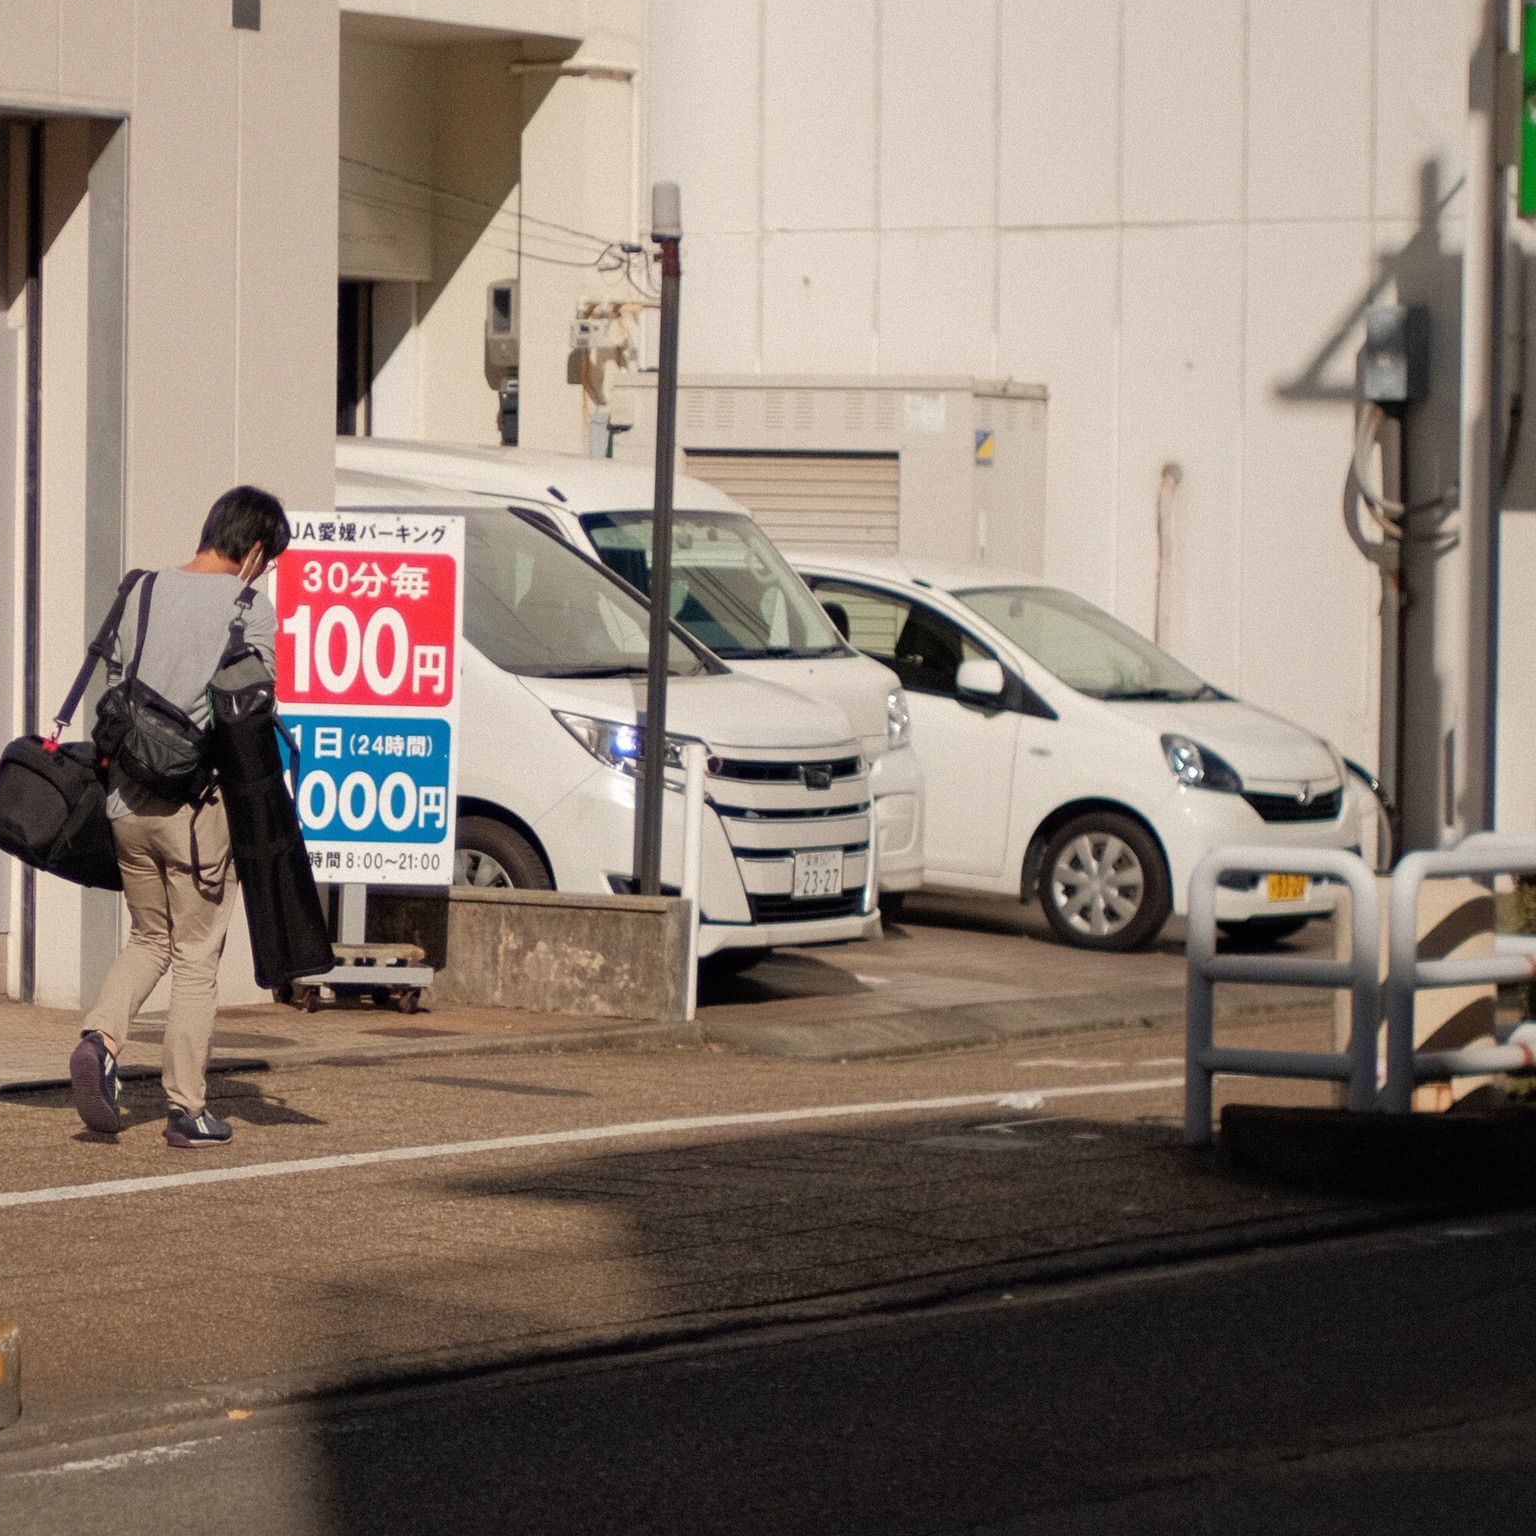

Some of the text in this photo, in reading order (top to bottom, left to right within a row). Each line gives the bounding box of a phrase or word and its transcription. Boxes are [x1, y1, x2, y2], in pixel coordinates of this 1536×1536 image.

[291, 522, 446, 544] JA愛媛パーキング
[303, 560, 430, 600] 30分毎
[283, 605, 446, 696] 100円
